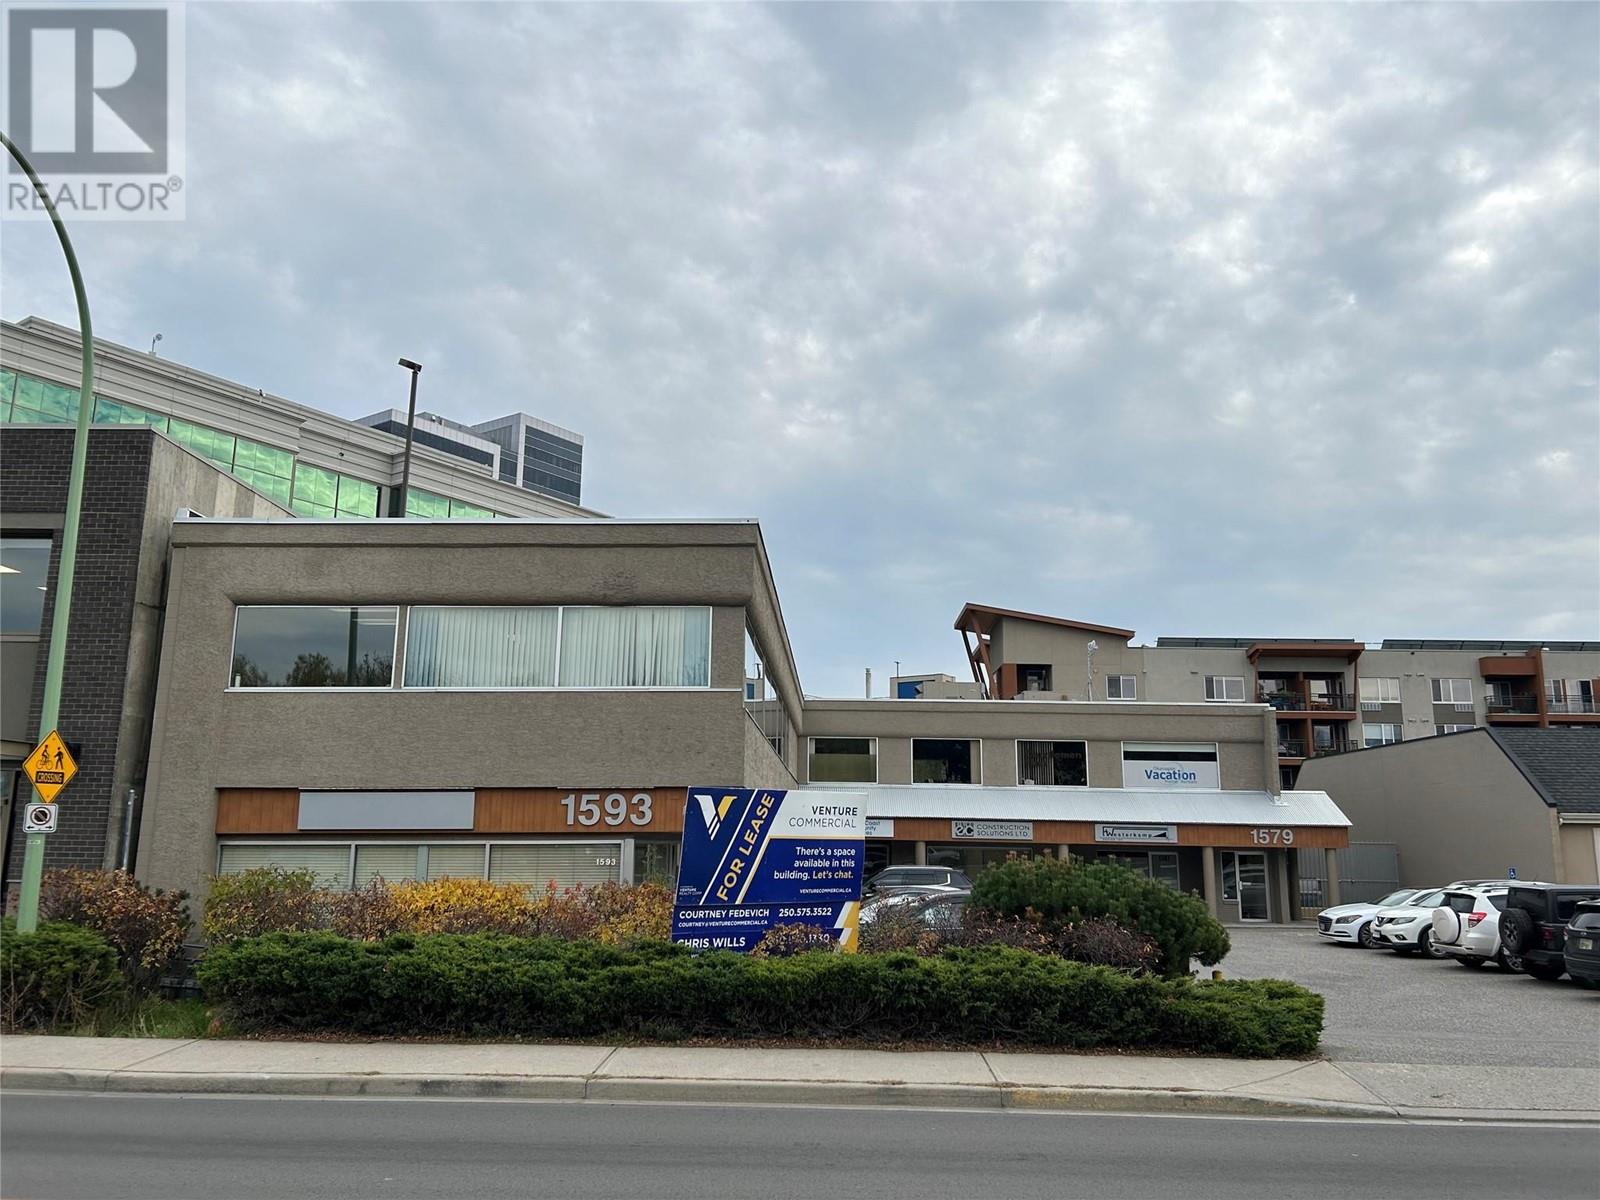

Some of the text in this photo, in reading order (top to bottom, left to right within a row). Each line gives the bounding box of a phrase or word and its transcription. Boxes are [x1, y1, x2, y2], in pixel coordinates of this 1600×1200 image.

[37, 772, 63, 783] CROSSING
[1144, 769, 1196, 781] Vacation
[560, 793, 653, 826] 1593
[811, 806, 859, 816] VENTURE
[788, 817, 857, 828] COMMERCIAL
[1250, 829, 1294, 845] 1579
[716, 792, 775, 901] FOR LEASE
[795, 846, 825, 856] There's
[833, 848, 856, 857] space
[595, 858, 617, 866] 1593
[793, 859, 855, 868] available in this
[773, 870, 854, 880] building. Let's chat.
[679, 908, 770, 919] COURTNEY FEDEVICH
[778, 907, 832, 917] 250.575.3522
[712, 936, 746, 948] WILLS
